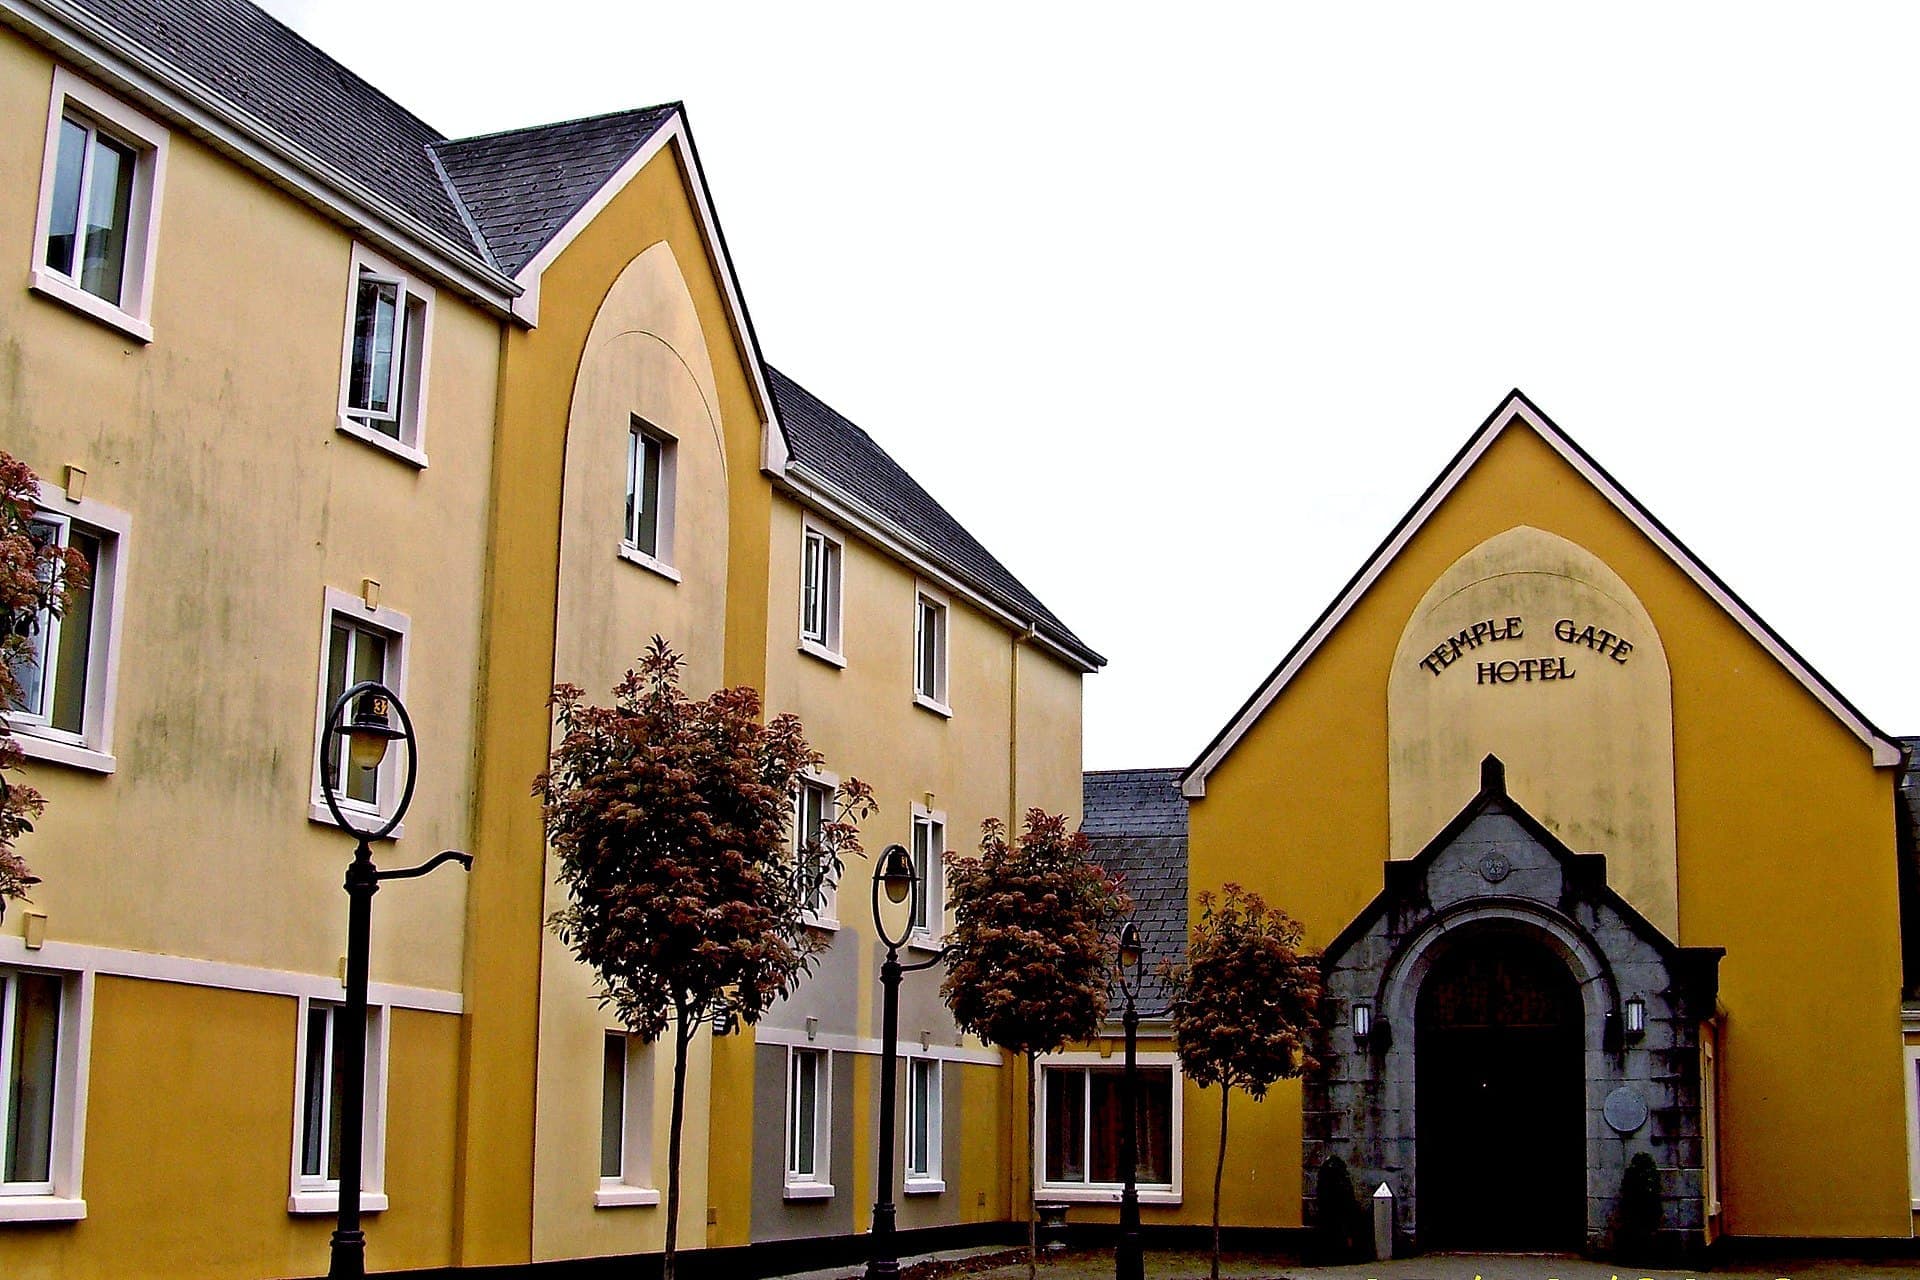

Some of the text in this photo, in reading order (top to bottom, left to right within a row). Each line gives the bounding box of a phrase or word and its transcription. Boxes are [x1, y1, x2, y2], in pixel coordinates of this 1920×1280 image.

[1419, 616, 1634, 677] TEMPLE GATE
[1476, 657, 1576, 685] HOTEL
